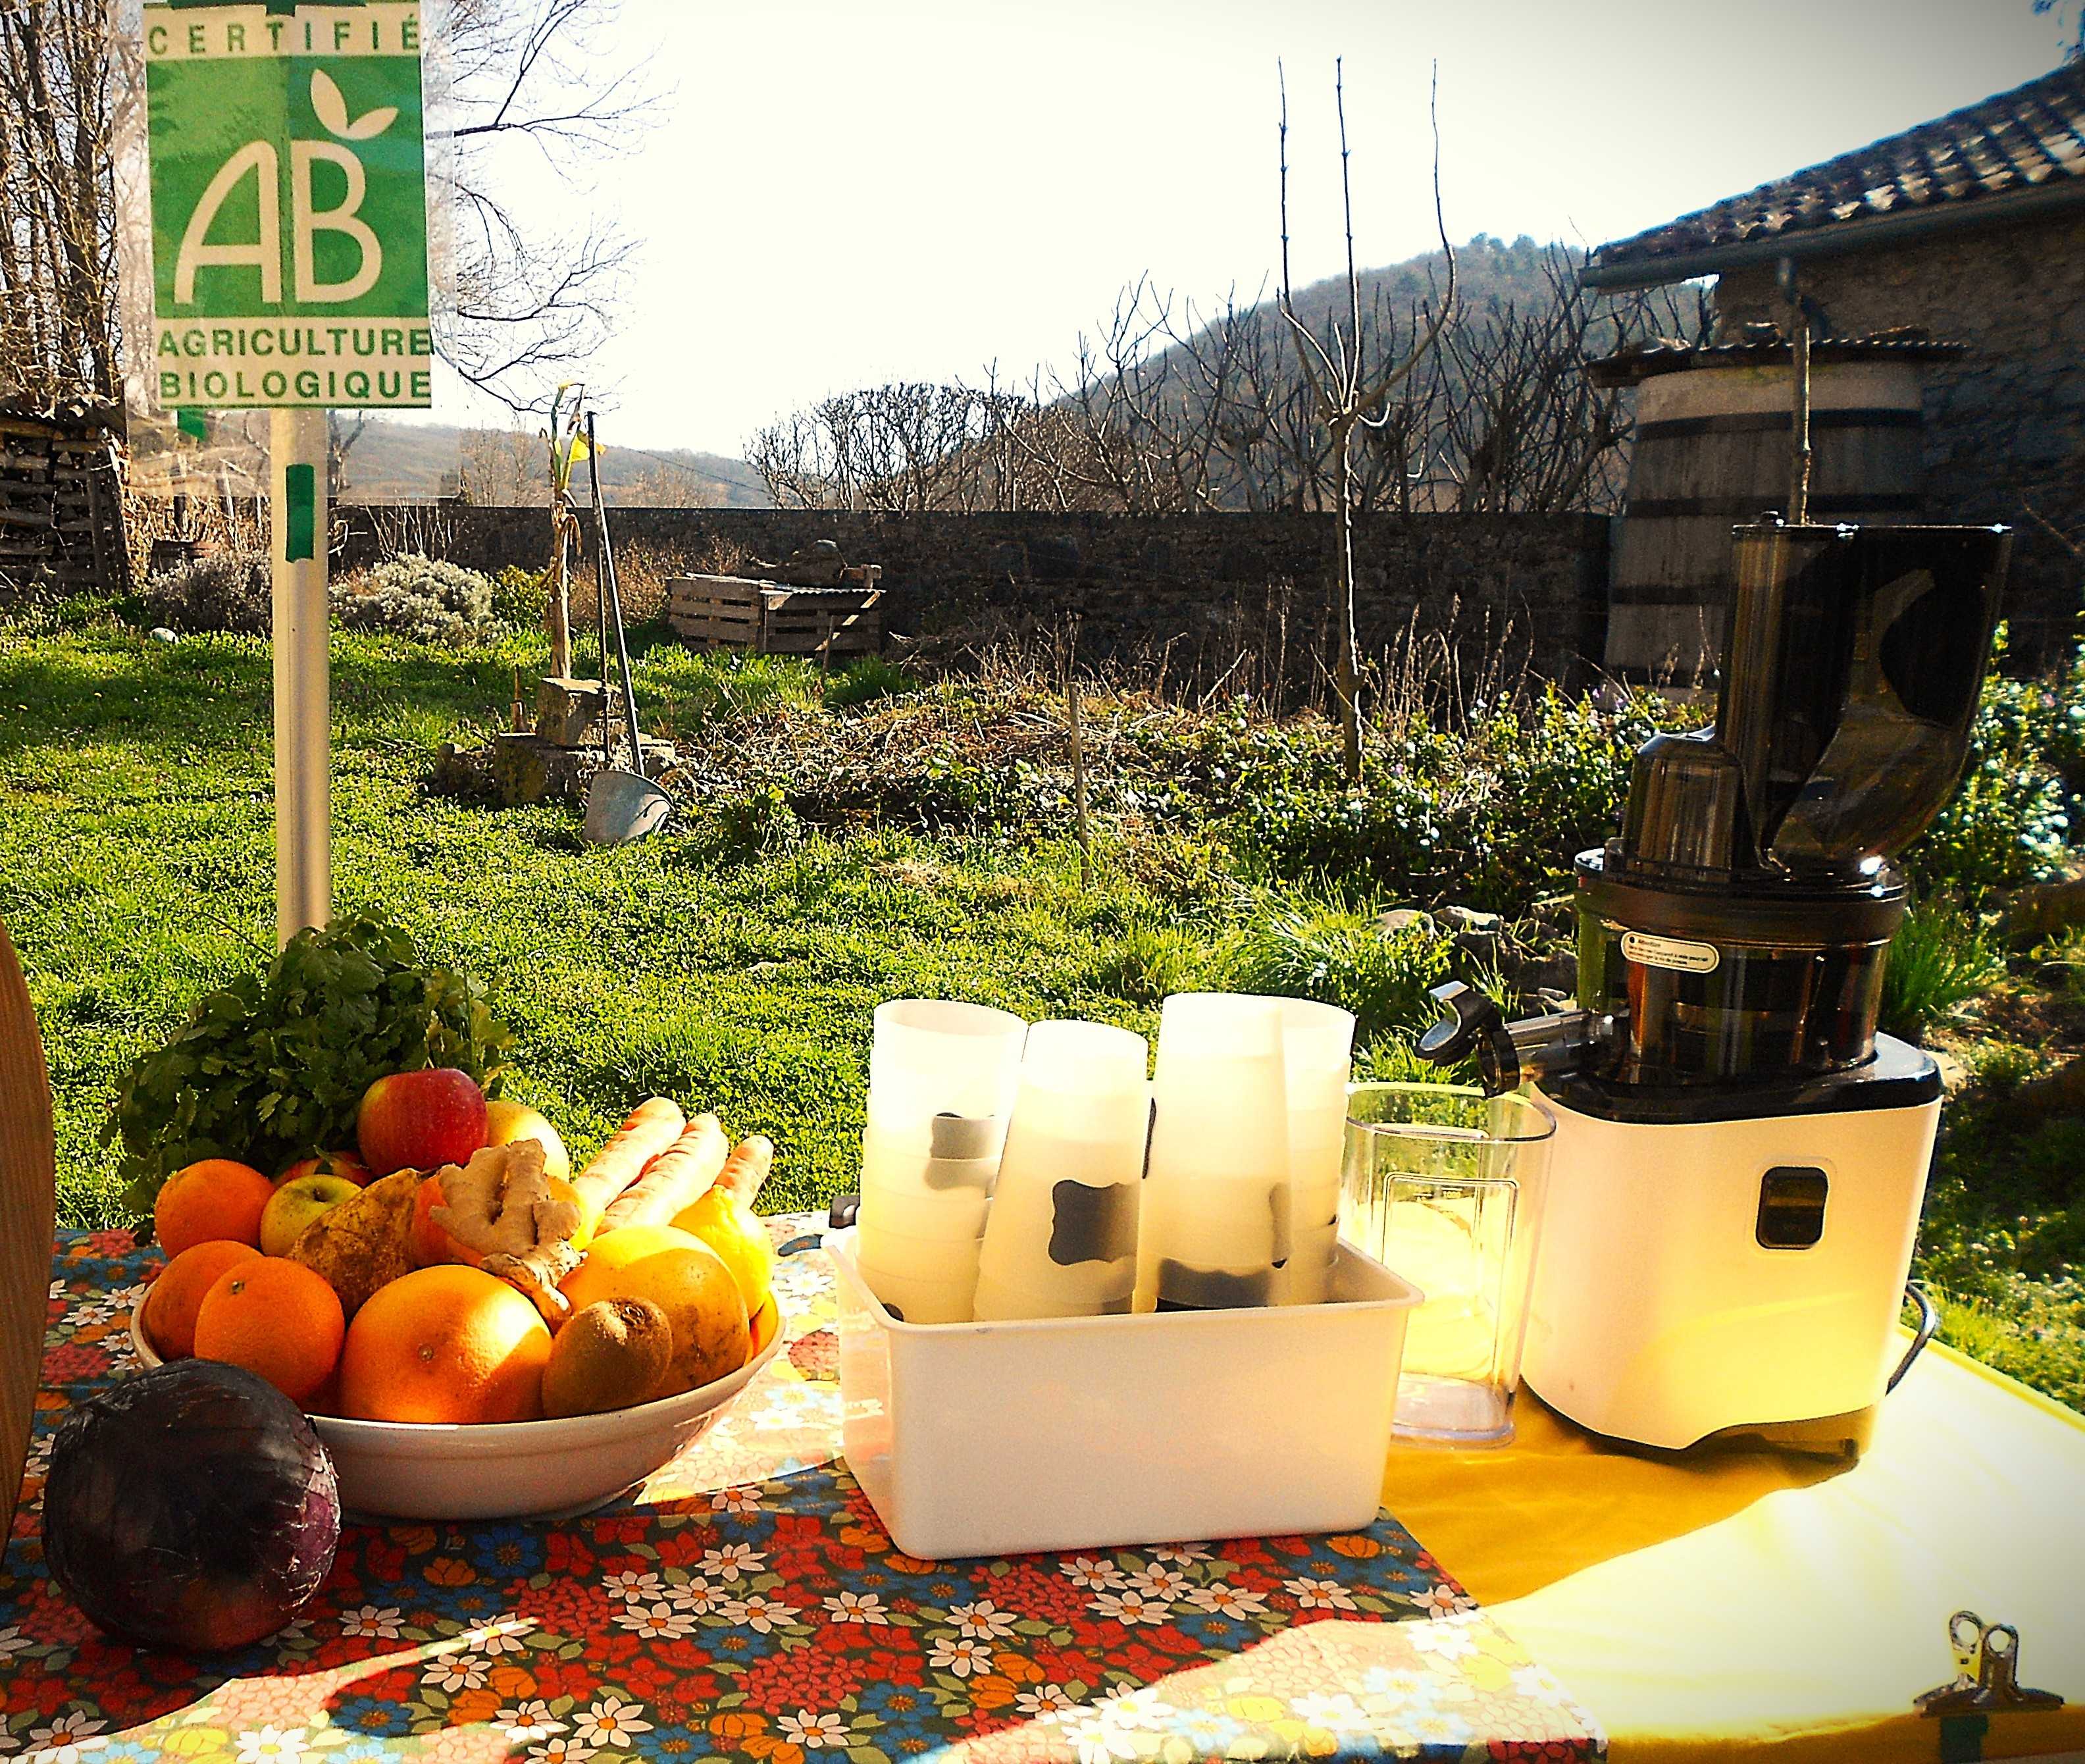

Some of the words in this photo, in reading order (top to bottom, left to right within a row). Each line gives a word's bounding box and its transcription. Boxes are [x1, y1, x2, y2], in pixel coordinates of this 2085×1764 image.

[148, 14, 419, 55] CERTIFIÉ
[174, 140, 382, 303] AB
[157, 328, 432, 356] AGRICULTURE
[160, 372, 432, 398] BIOLOGIQUE
